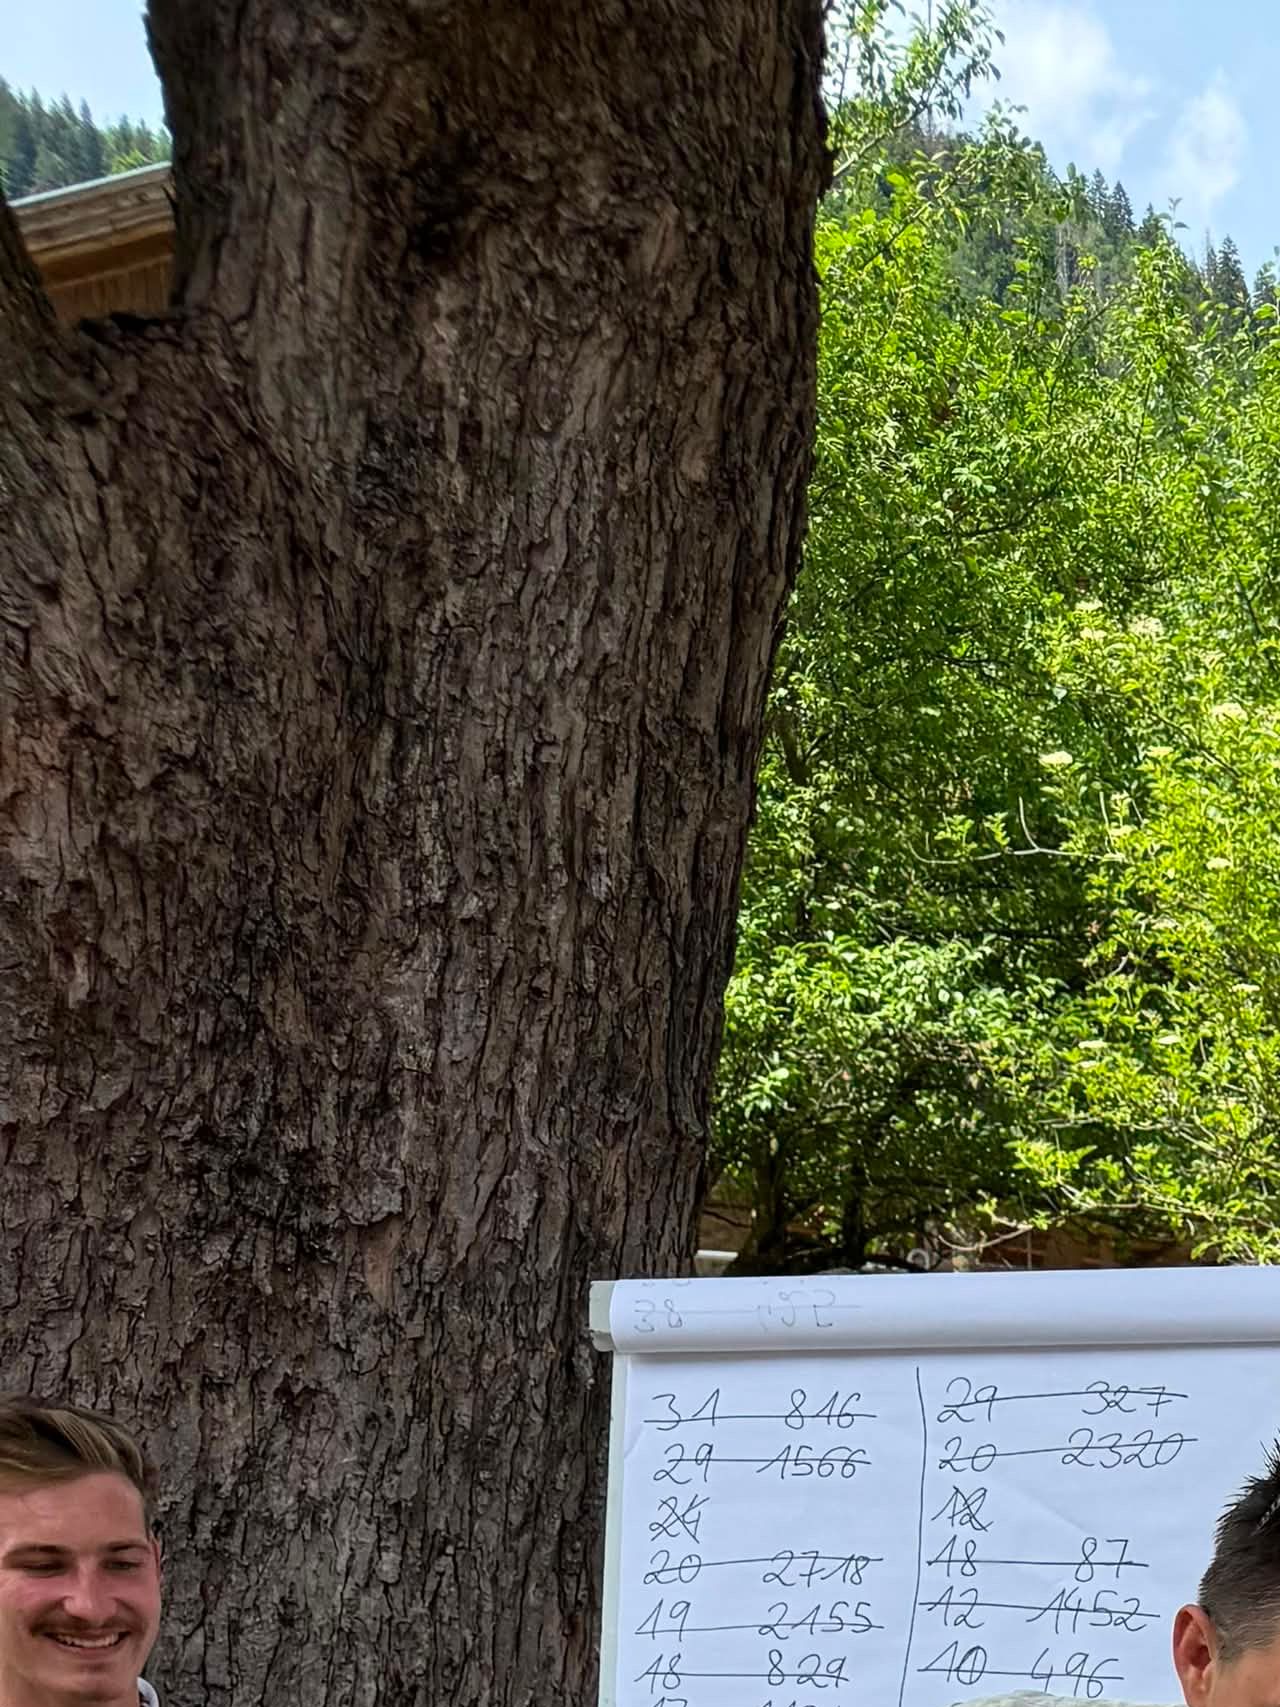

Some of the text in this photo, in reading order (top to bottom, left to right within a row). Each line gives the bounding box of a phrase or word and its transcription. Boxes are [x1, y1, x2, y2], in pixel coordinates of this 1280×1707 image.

[652, 1388, 861, 1431] 31 816
[937, 1377, 1173, 1422] 29 327
[653, 1443, 866, 1484] 29 1566
[939, 1428, 1184, 1472] 20 2320
[643, 1550, 870, 1587] 20 2718
[927, 1535, 1133, 1582] 18 87
[635, 1599, 873, 1641] 19 2155
[927, 1586, 1147, 1634] 12 1452
[634, 1649, 847, 1694] 18 829
[1031, 1648, 1119, 1699] 496
